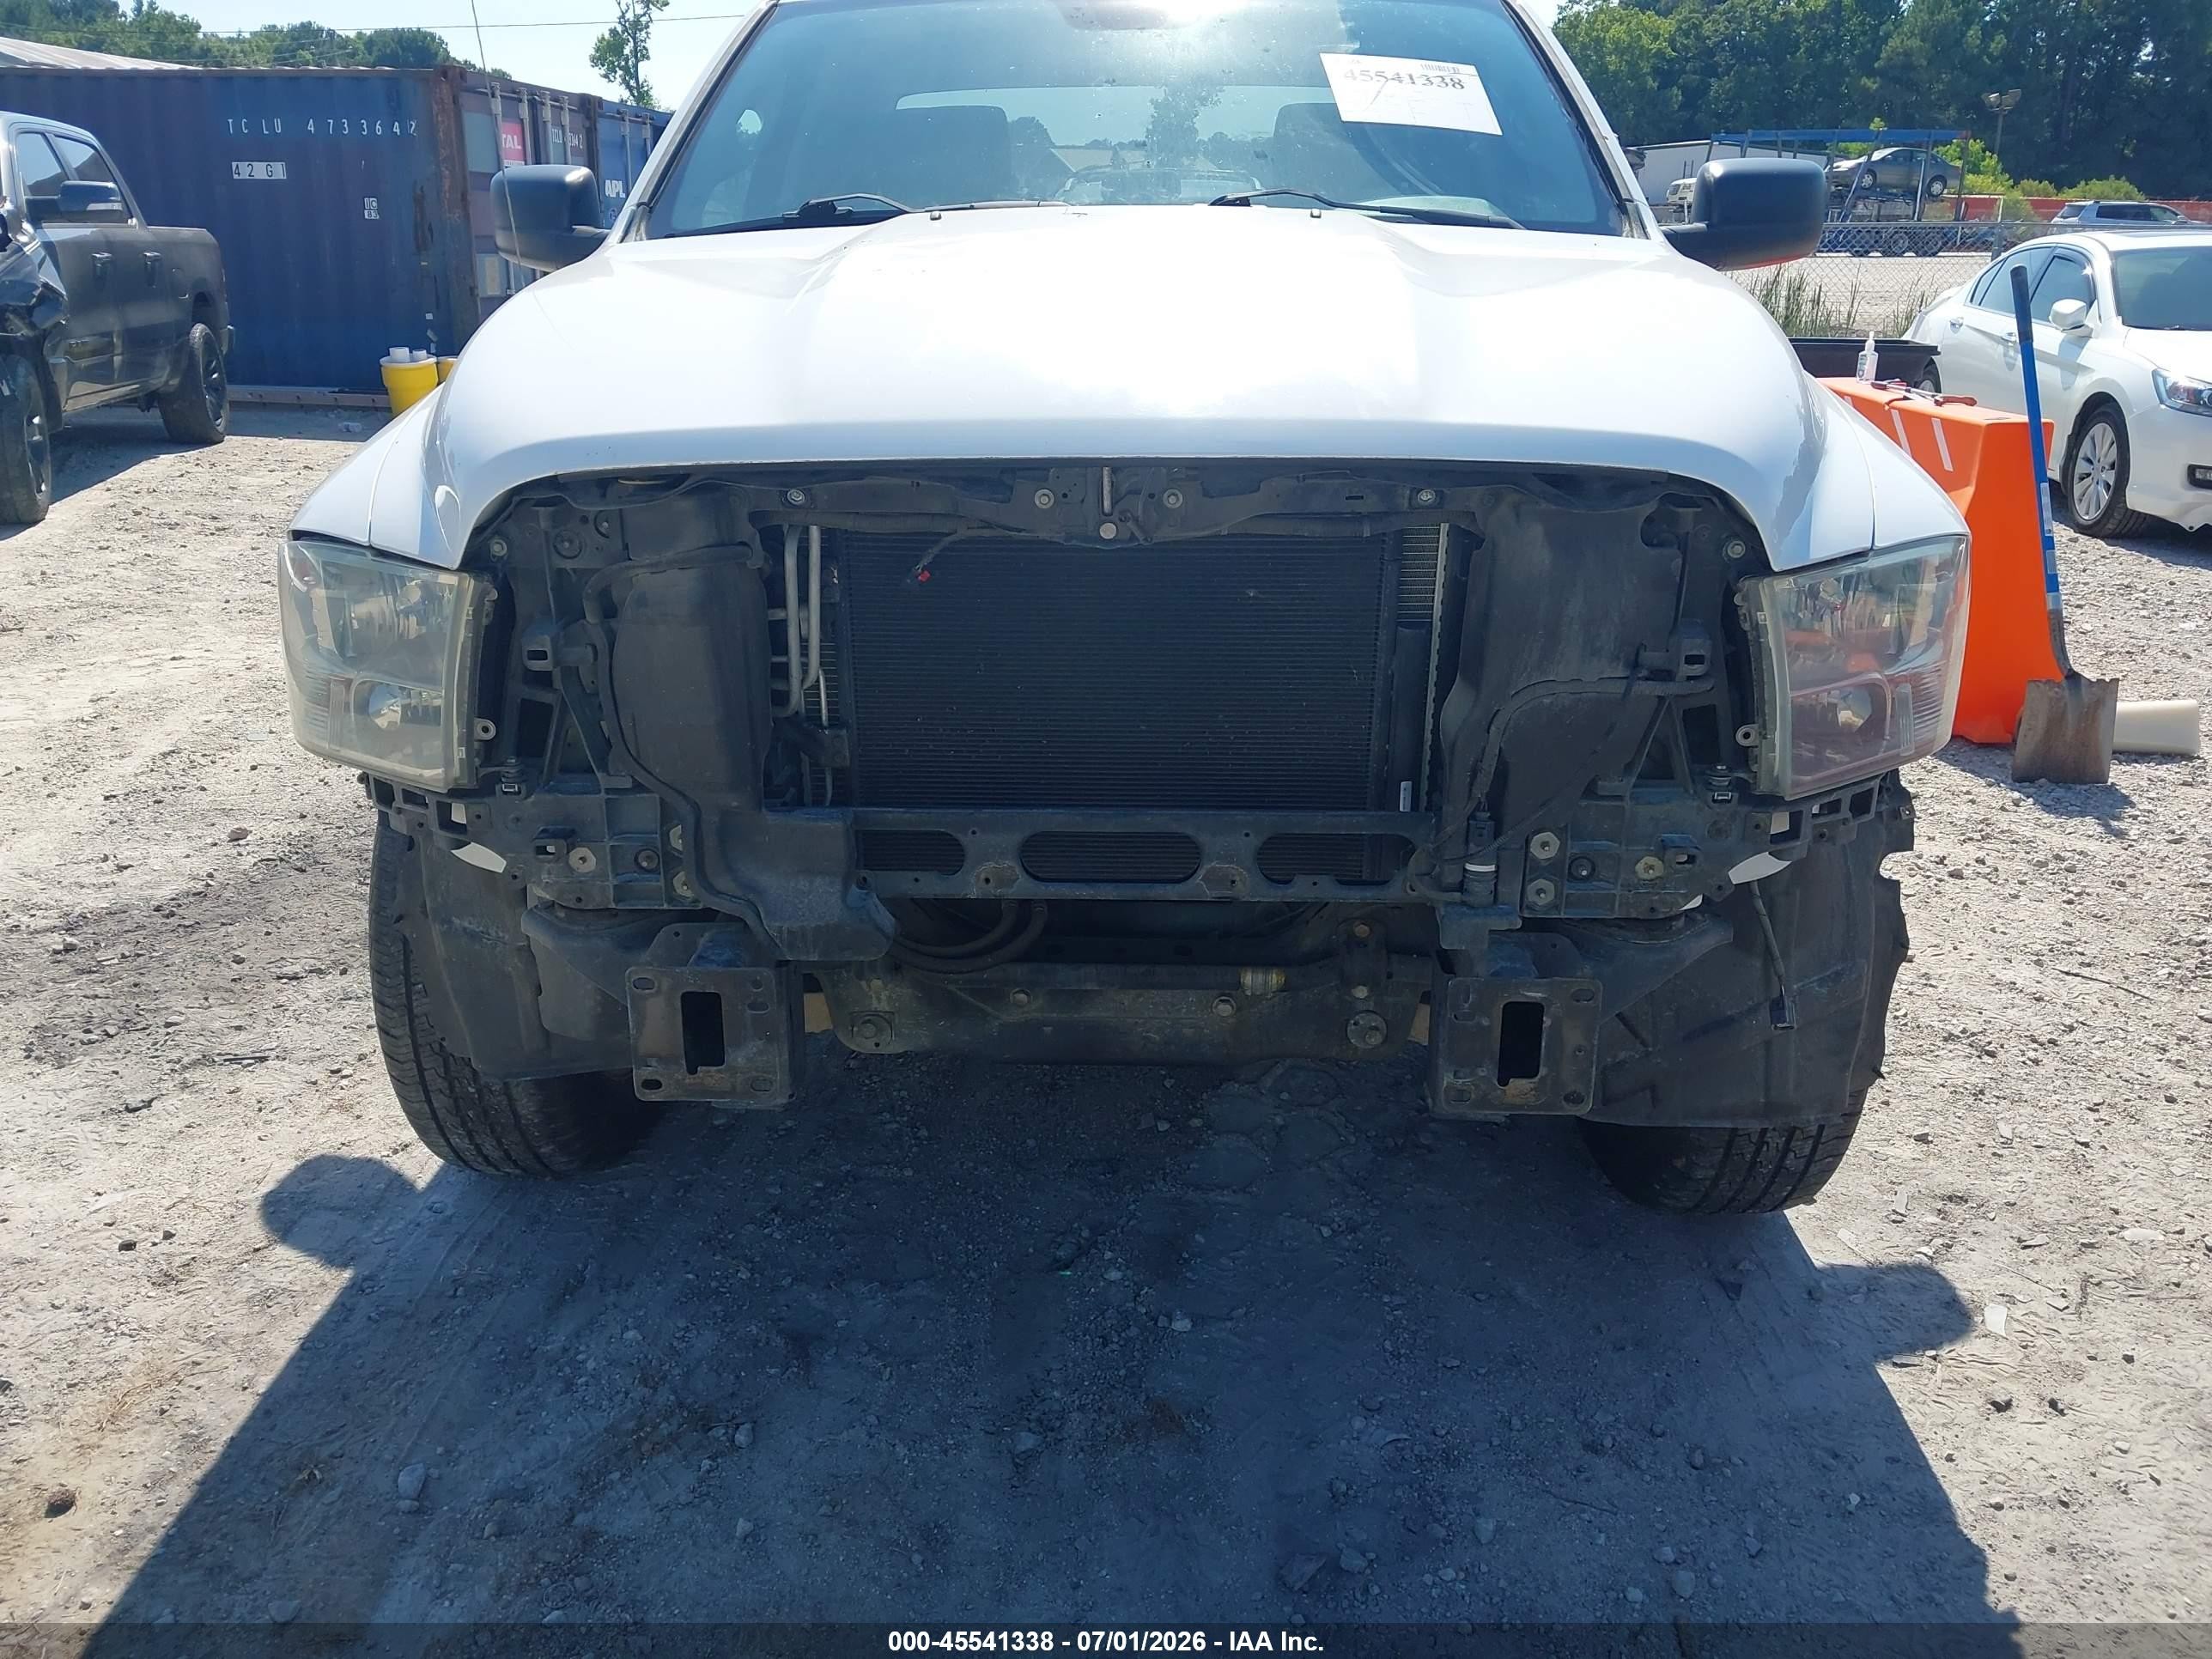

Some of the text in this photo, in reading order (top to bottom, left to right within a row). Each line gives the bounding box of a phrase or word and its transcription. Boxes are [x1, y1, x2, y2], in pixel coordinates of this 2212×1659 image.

[1344, 68, 1465, 91] 45541338
[228, 118, 282, 134] TCLU
[605, 179, 626, 198] APL
